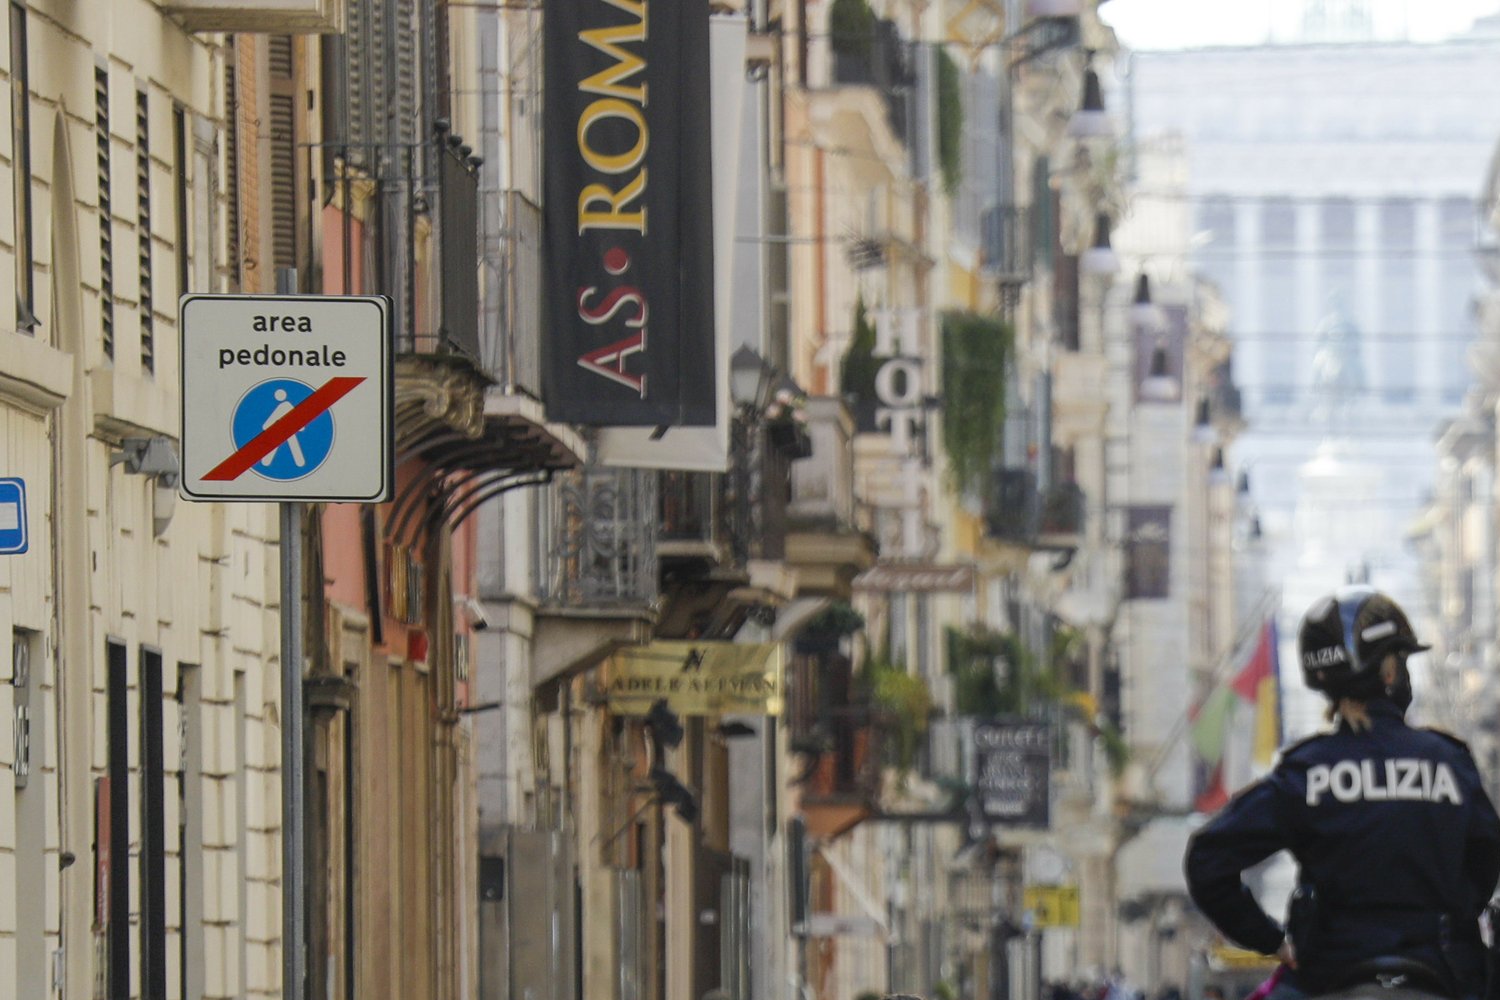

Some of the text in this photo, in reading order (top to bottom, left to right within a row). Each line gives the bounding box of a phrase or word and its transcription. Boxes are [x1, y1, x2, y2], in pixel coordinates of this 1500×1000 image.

[577, 0, 650, 400] AS ROM
[253, 315, 312, 333] area
[219, 344, 346, 369] pedonale
[1303, 645, 1345, 668] OLIZIA
[1306, 758, 1462, 806] POLIZIA
